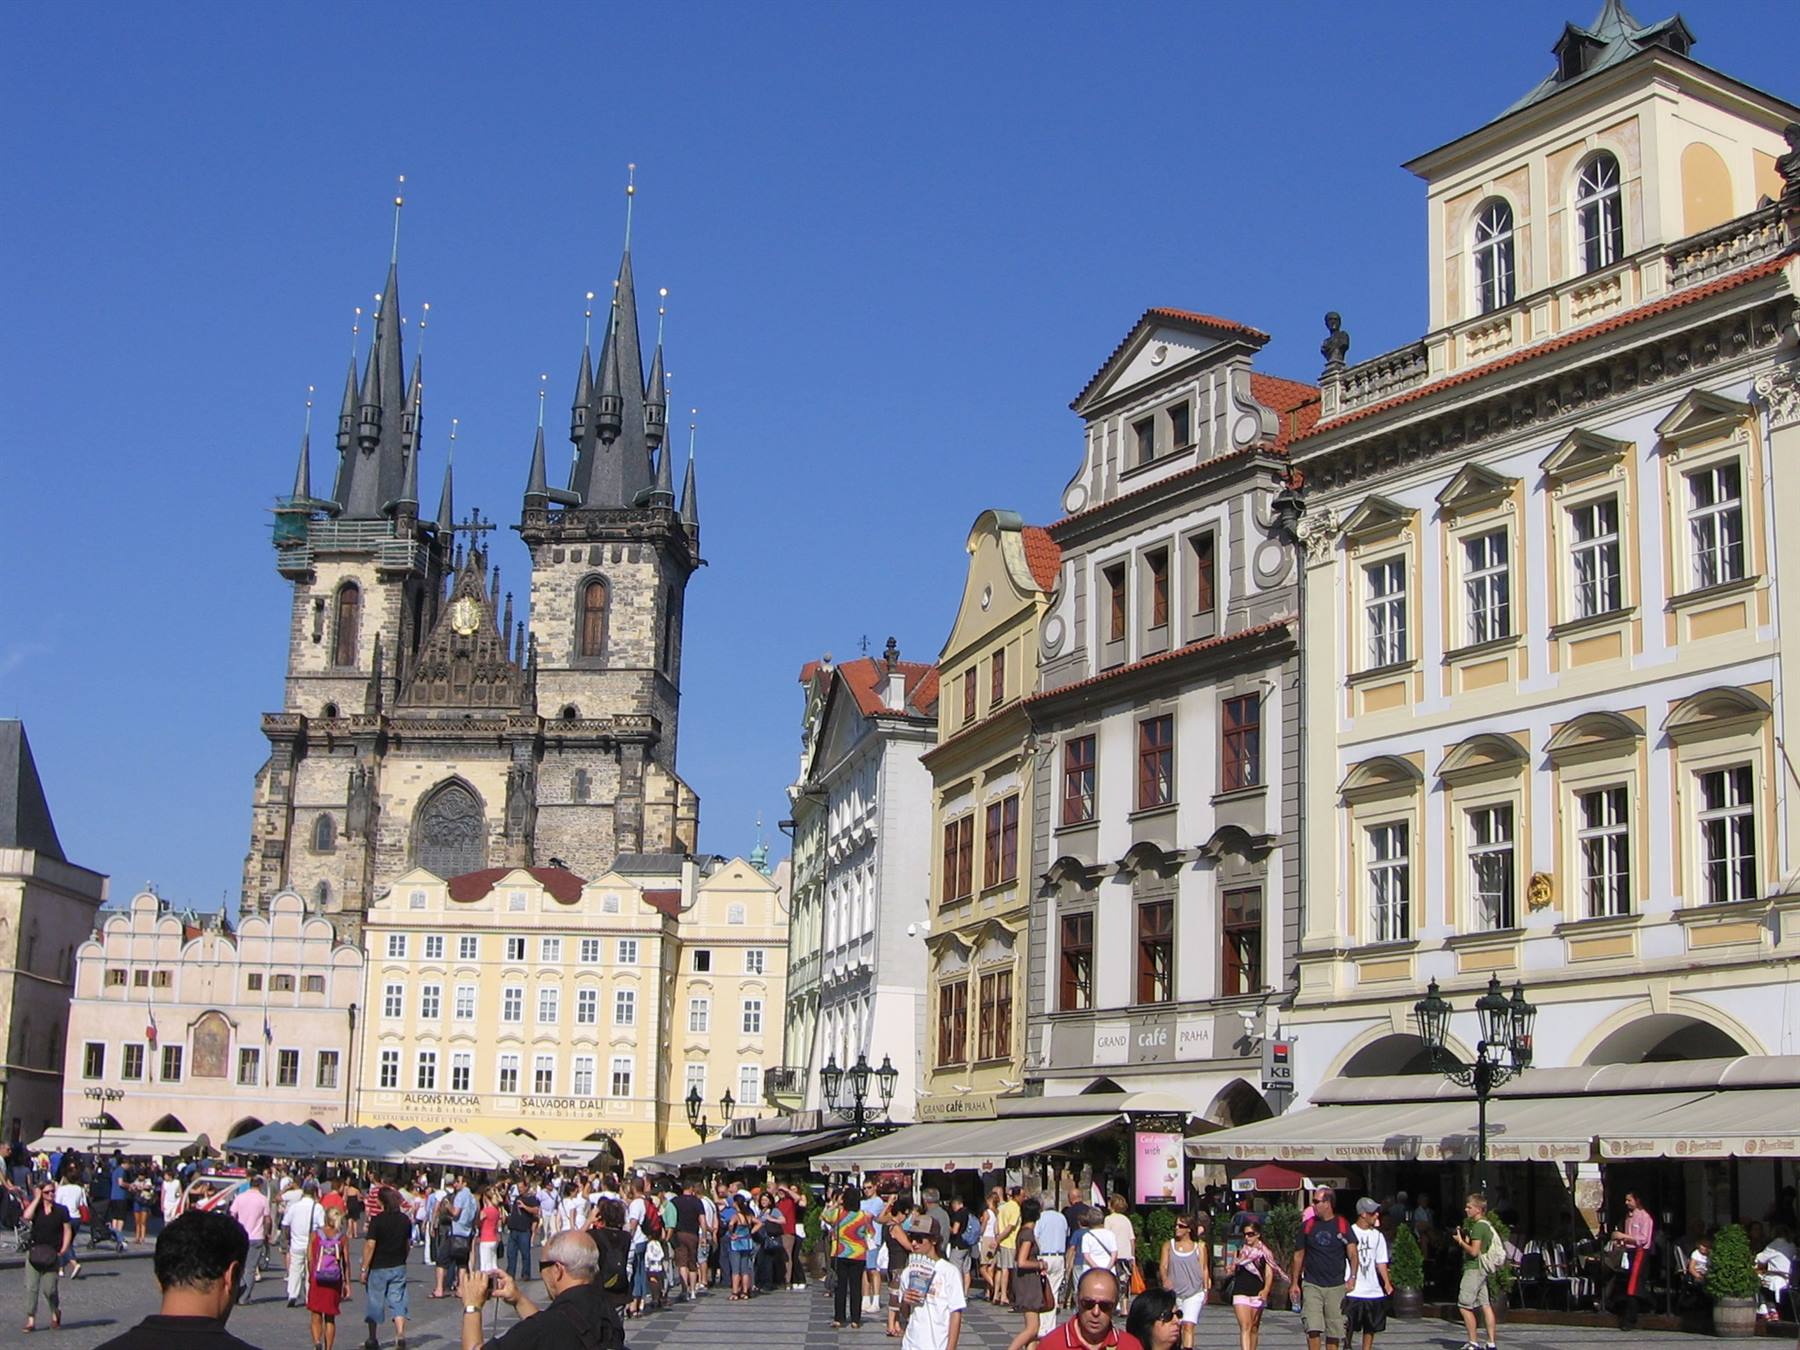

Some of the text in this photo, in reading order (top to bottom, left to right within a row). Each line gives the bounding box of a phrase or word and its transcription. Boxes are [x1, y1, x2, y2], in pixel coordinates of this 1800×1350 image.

[1097, 1027, 1209, 1048] GRAND café PRAHA
[1271, 1067, 1290, 1078] KB
[404, 1094, 480, 1105] ALFONS MUCHA
[522, 1098, 576, 1109] SALVADOR
[923, 1100, 987, 1114] GRAND café PRAHA
